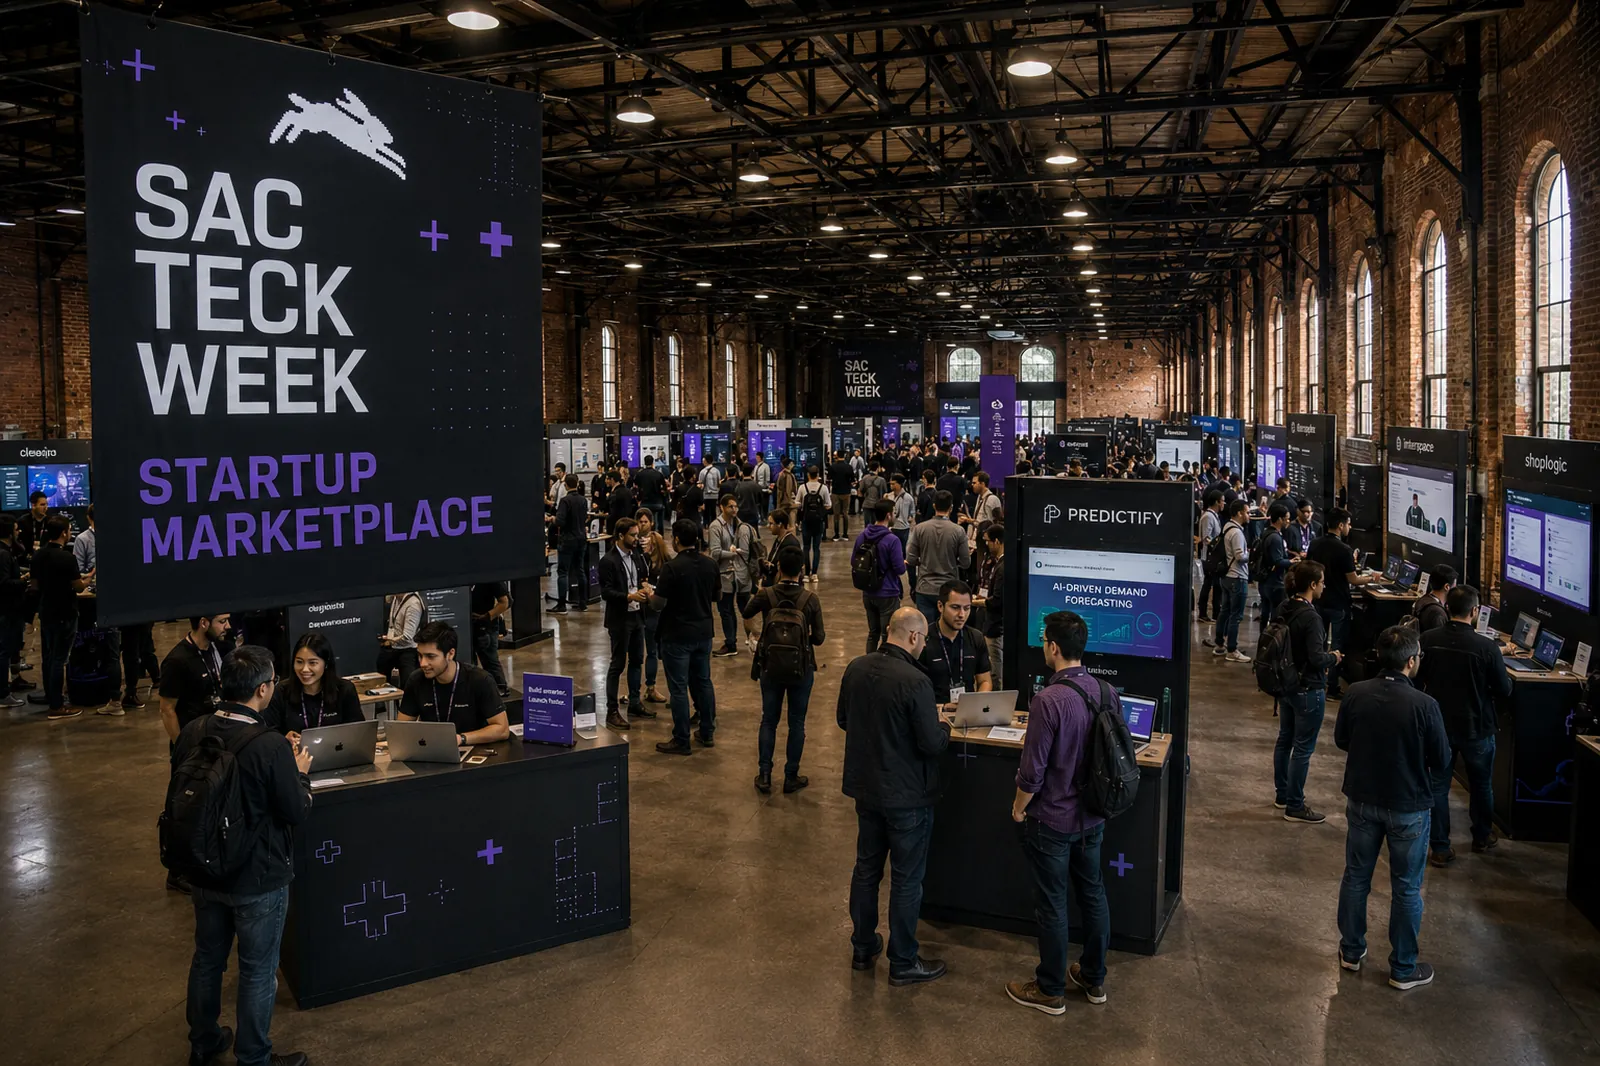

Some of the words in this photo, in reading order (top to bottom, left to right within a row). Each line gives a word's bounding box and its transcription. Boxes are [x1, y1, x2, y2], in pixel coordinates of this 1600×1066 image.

[135, 163, 303, 250] SAC
[135, 249, 354, 337] TECK
[844, 360, 869, 372] SAC
[137, 341, 369, 416] WEEK
[844, 372, 877, 385] TECK
[845, 385, 881, 398] WEEK
[1524, 452, 1568, 475] shoplogic
[139, 451, 378, 506] STARTUP
[1068, 508, 1164, 526] PREDICTIFY
[141, 495, 494, 564] MARKETPLACE
[1052, 582, 1102, 595] AI-DRIVEN
[1104, 586, 1148, 598] DEMAND
[1064, 595, 1133, 609] FORECASTING
